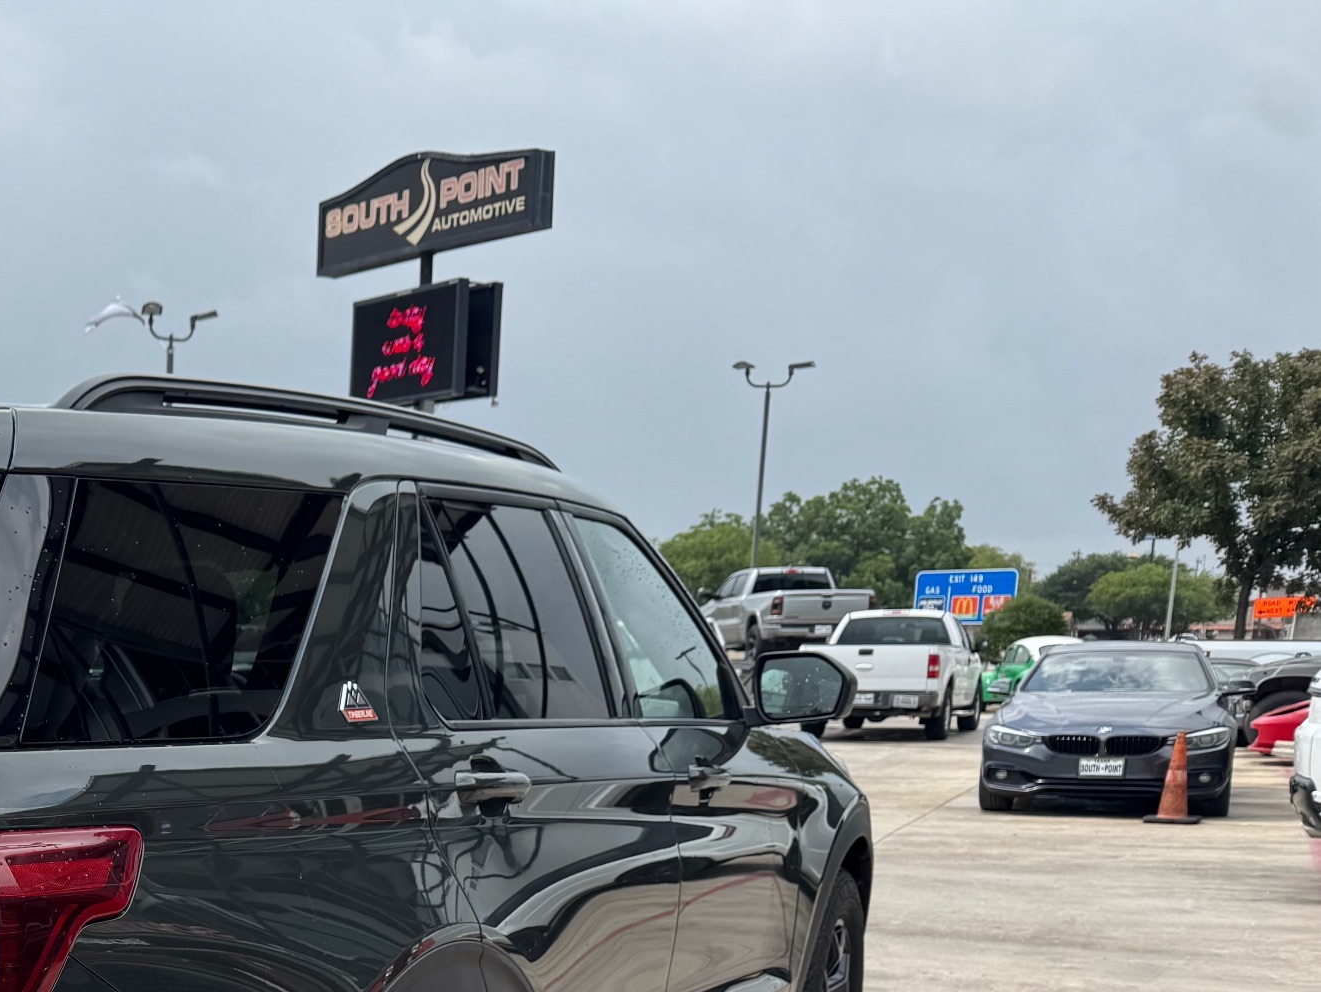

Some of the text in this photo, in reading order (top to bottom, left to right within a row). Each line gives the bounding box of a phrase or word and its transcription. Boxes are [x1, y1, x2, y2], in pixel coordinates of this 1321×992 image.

[325, 158, 525, 238] SOUTH POINT
[431, 196, 525, 233] AUTOMOTIVE
[949, 574, 965, 584] EXIT
[925, 586, 940, 595] GAS
[972, 585, 993, 594] FOOD
[1080, 764, 1122, 773] SOUTH POINT
